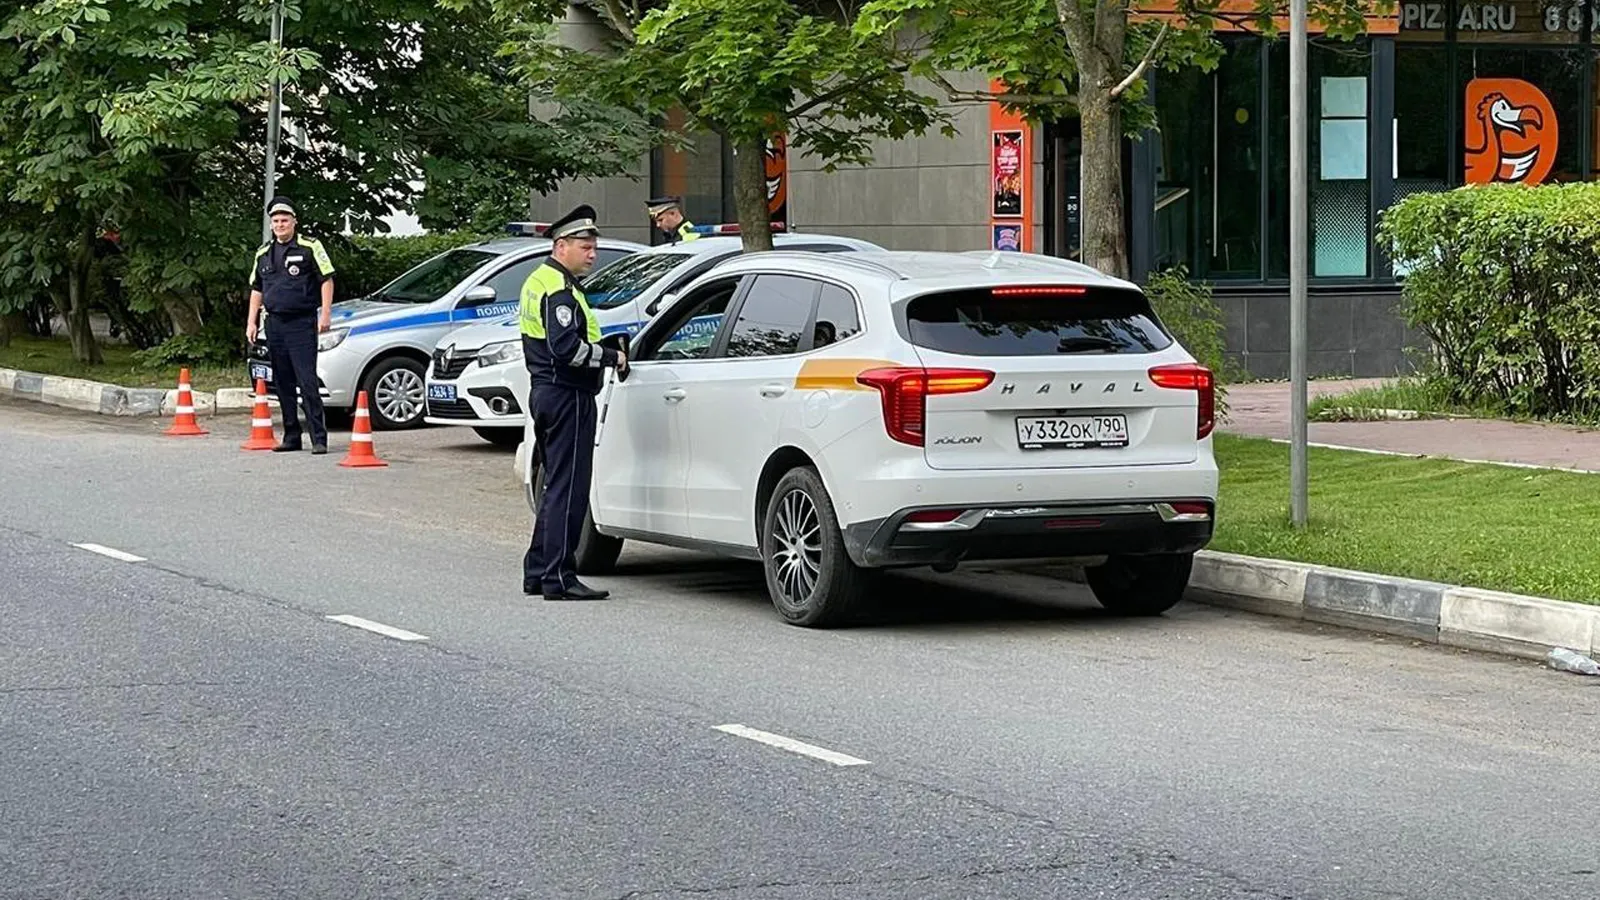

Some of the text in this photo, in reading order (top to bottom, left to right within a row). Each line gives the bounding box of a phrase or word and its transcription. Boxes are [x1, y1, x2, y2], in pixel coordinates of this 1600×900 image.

[1399, 3, 1516, 31] PIZA.RU
[1001, 382, 1144, 394] HAVAL
[1095, 418, 1121, 433] 790
[934, 436, 982, 444] JOLION
